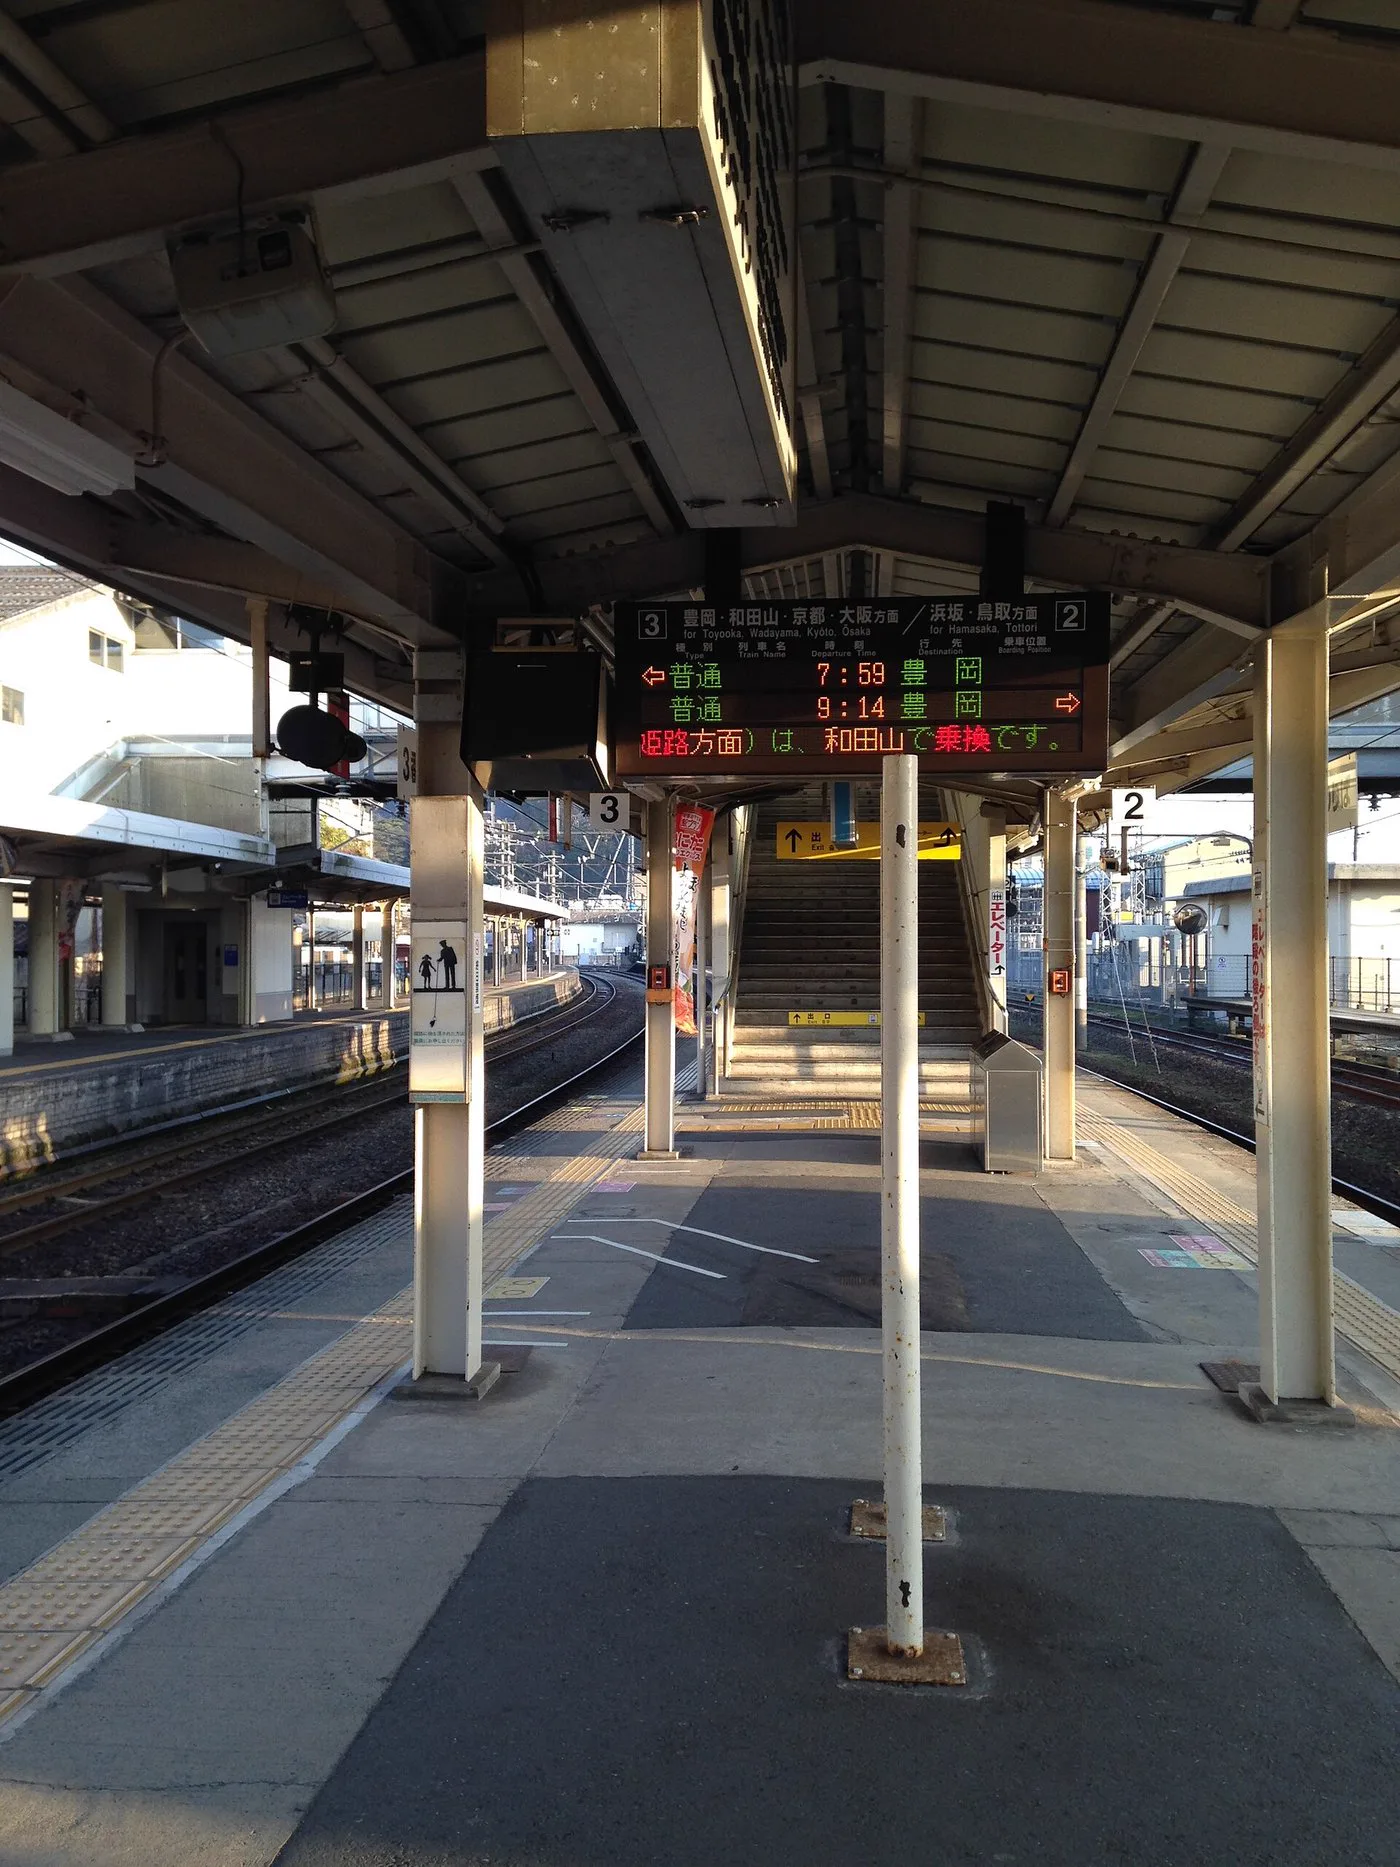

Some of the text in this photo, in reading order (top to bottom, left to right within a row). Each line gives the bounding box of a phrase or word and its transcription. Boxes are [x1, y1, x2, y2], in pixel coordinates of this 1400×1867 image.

[1062, 605, 1079, 628] 2
[644, 613, 660, 636] 3
[929, 623, 1038, 635] for Hamasaka, Tottori
[684, 629, 697, 639] for
[1004, 636, 1047, 646] 乗車位置
[811, 649, 876, 658] Departure Time
[918, 648, 963, 656] Destination
[998, 645, 1051, 654] Boarding Position
[685, 652, 704, 660] Type
[669, 662, 723, 689] 普通
[669, 695, 723, 722] 普通
[600, 795, 619, 823] 3
[1124, 792, 1144, 820] 2
[811, 843, 825, 851] Exit
[990, 902, 1006, 964] エレベーター
